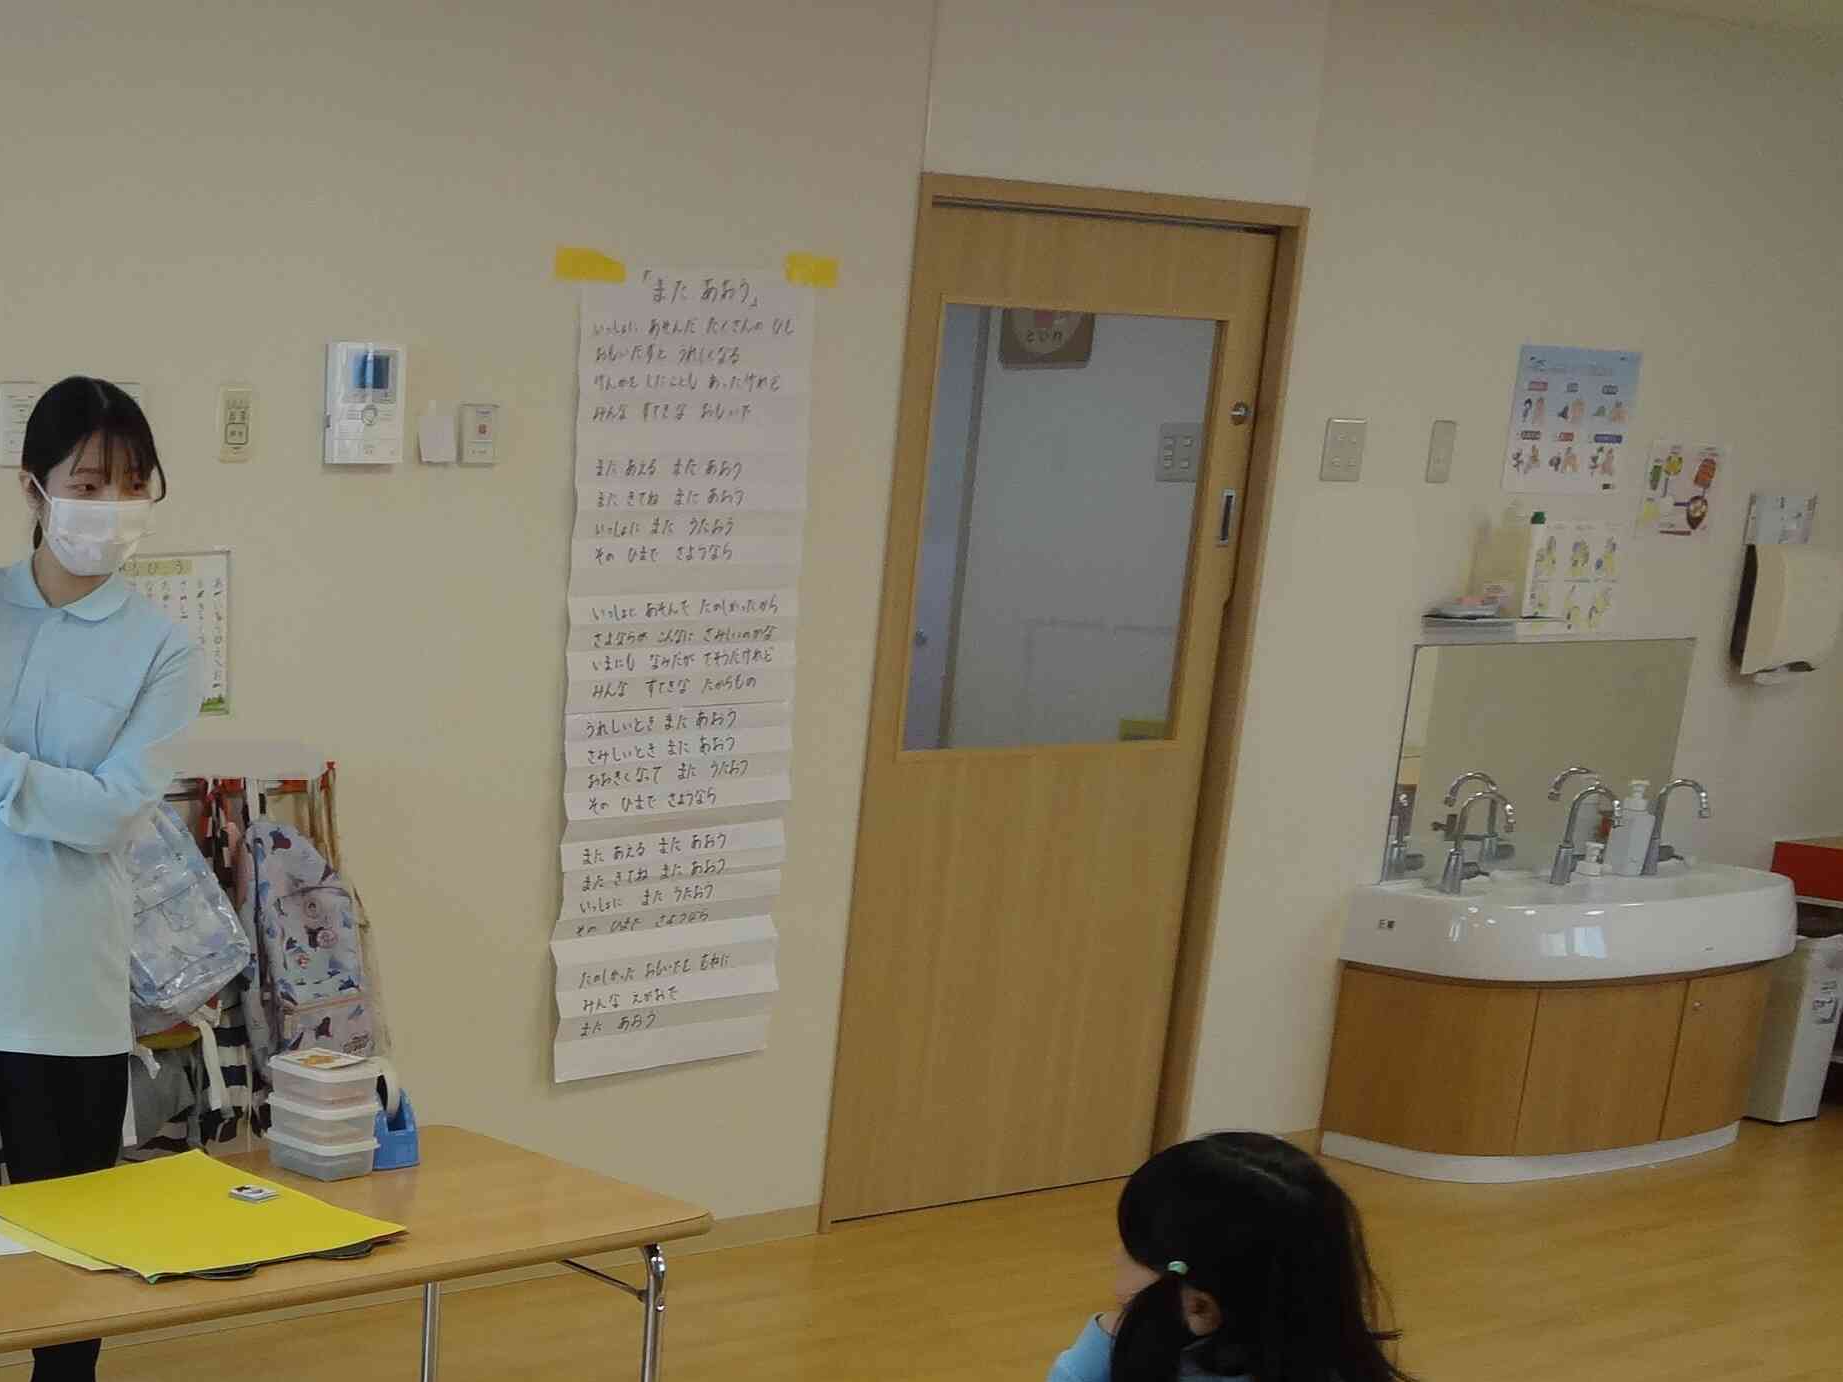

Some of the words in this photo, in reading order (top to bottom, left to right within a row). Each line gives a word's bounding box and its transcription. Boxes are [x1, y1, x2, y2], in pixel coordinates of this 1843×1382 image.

[676, 543, 732, 561] さようなら
[592, 680, 629, 697] みんな
[664, 713, 687, 731] また
[696, 710, 737, 730] あおう
[667, 739, 689, 757] また
[699, 736, 735, 754] あおう
[677, 762, 697, 780] また
[667, 788, 717, 808] さようなら
[582, 848, 604, 865] また
[613, 842, 646, 860] あえる
[659, 837, 682, 855] また
[690, 834, 727, 849] あおう
[582, 875, 604, 892] また
[659, 864, 684, 881] また
[690, 858, 725, 876] あおう
[641, 889, 663, 906] また
[580, 1021, 603, 1038] また
[616, 1014, 657, 1031] あおう
